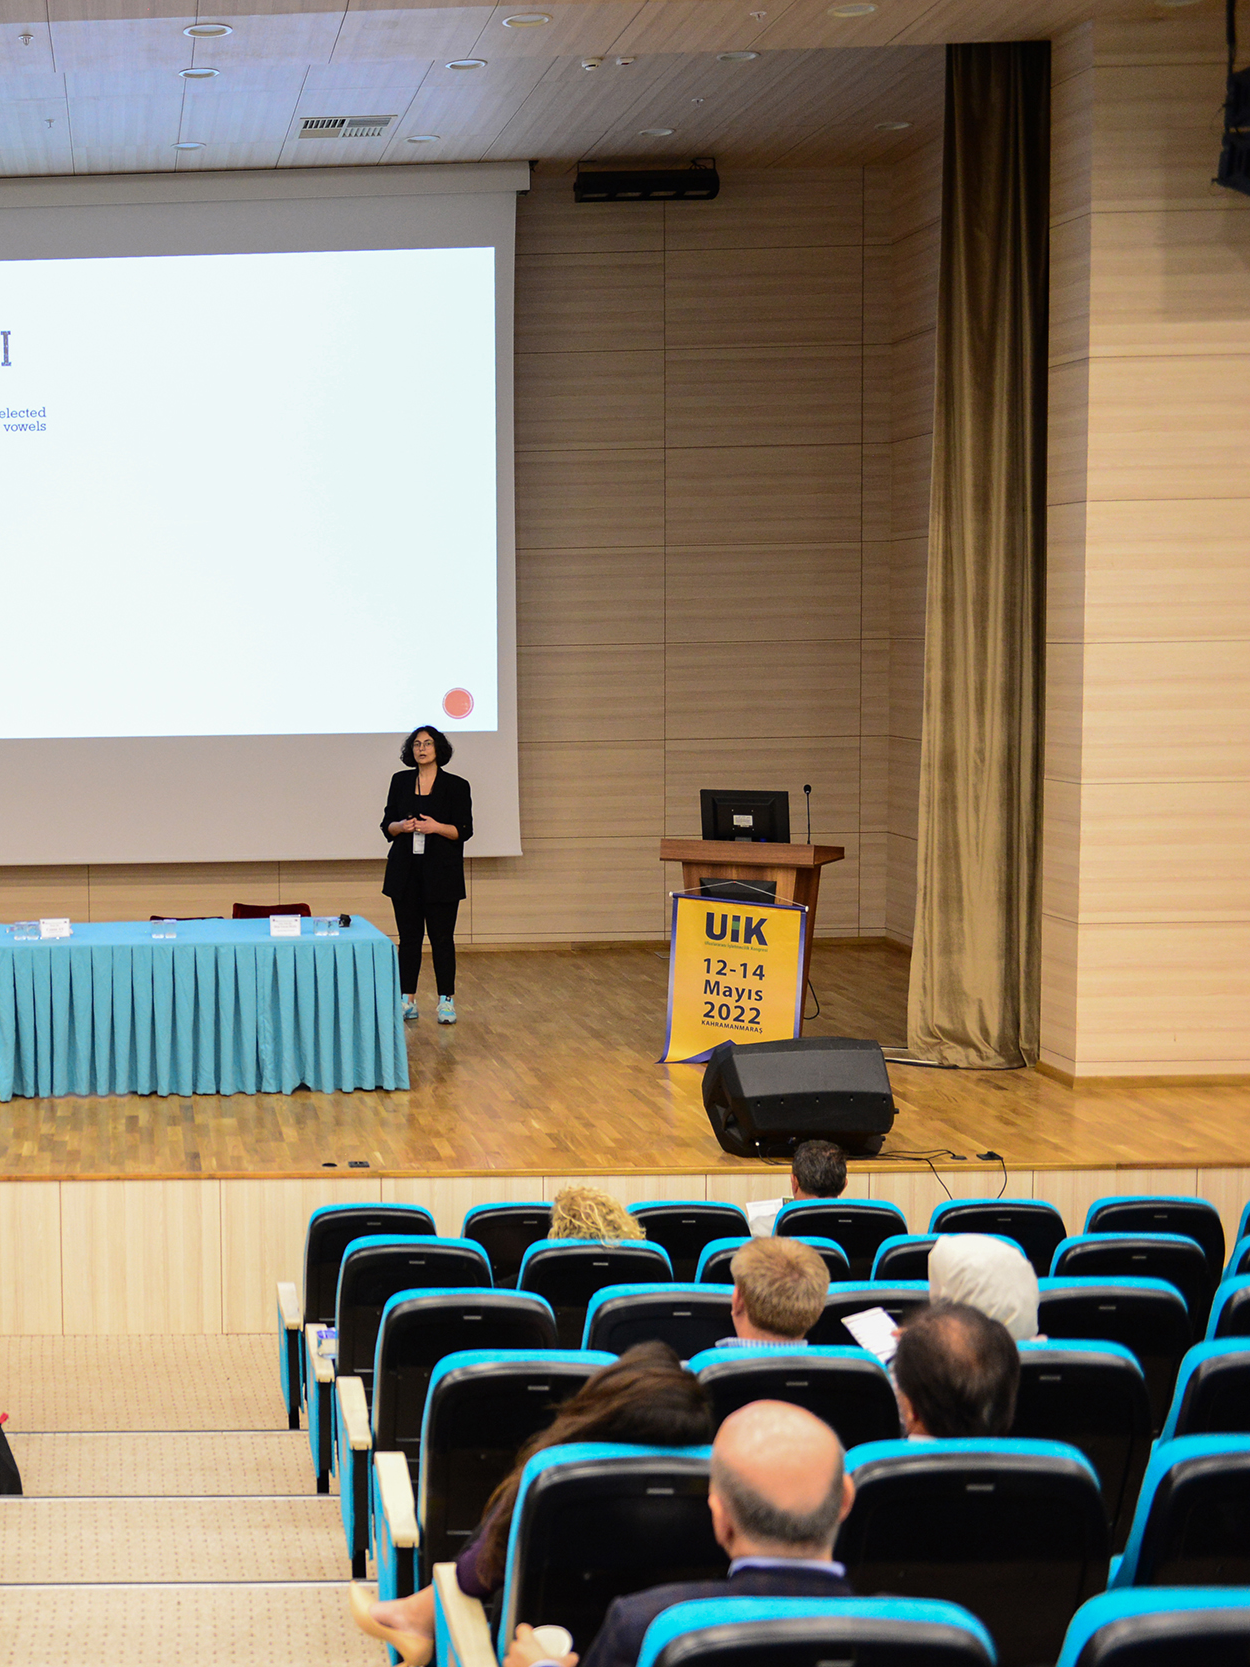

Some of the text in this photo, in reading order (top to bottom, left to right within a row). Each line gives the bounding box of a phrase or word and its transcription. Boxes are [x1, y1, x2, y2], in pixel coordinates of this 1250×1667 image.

[3, 420, 47, 432] vowels
[703, 957, 766, 981] 12-14
[703, 979, 764, 1003] Mayıs
[702, 1000, 761, 1025] 2022
[701, 1019, 764, 1035] KAHRAMANMARAŞ
